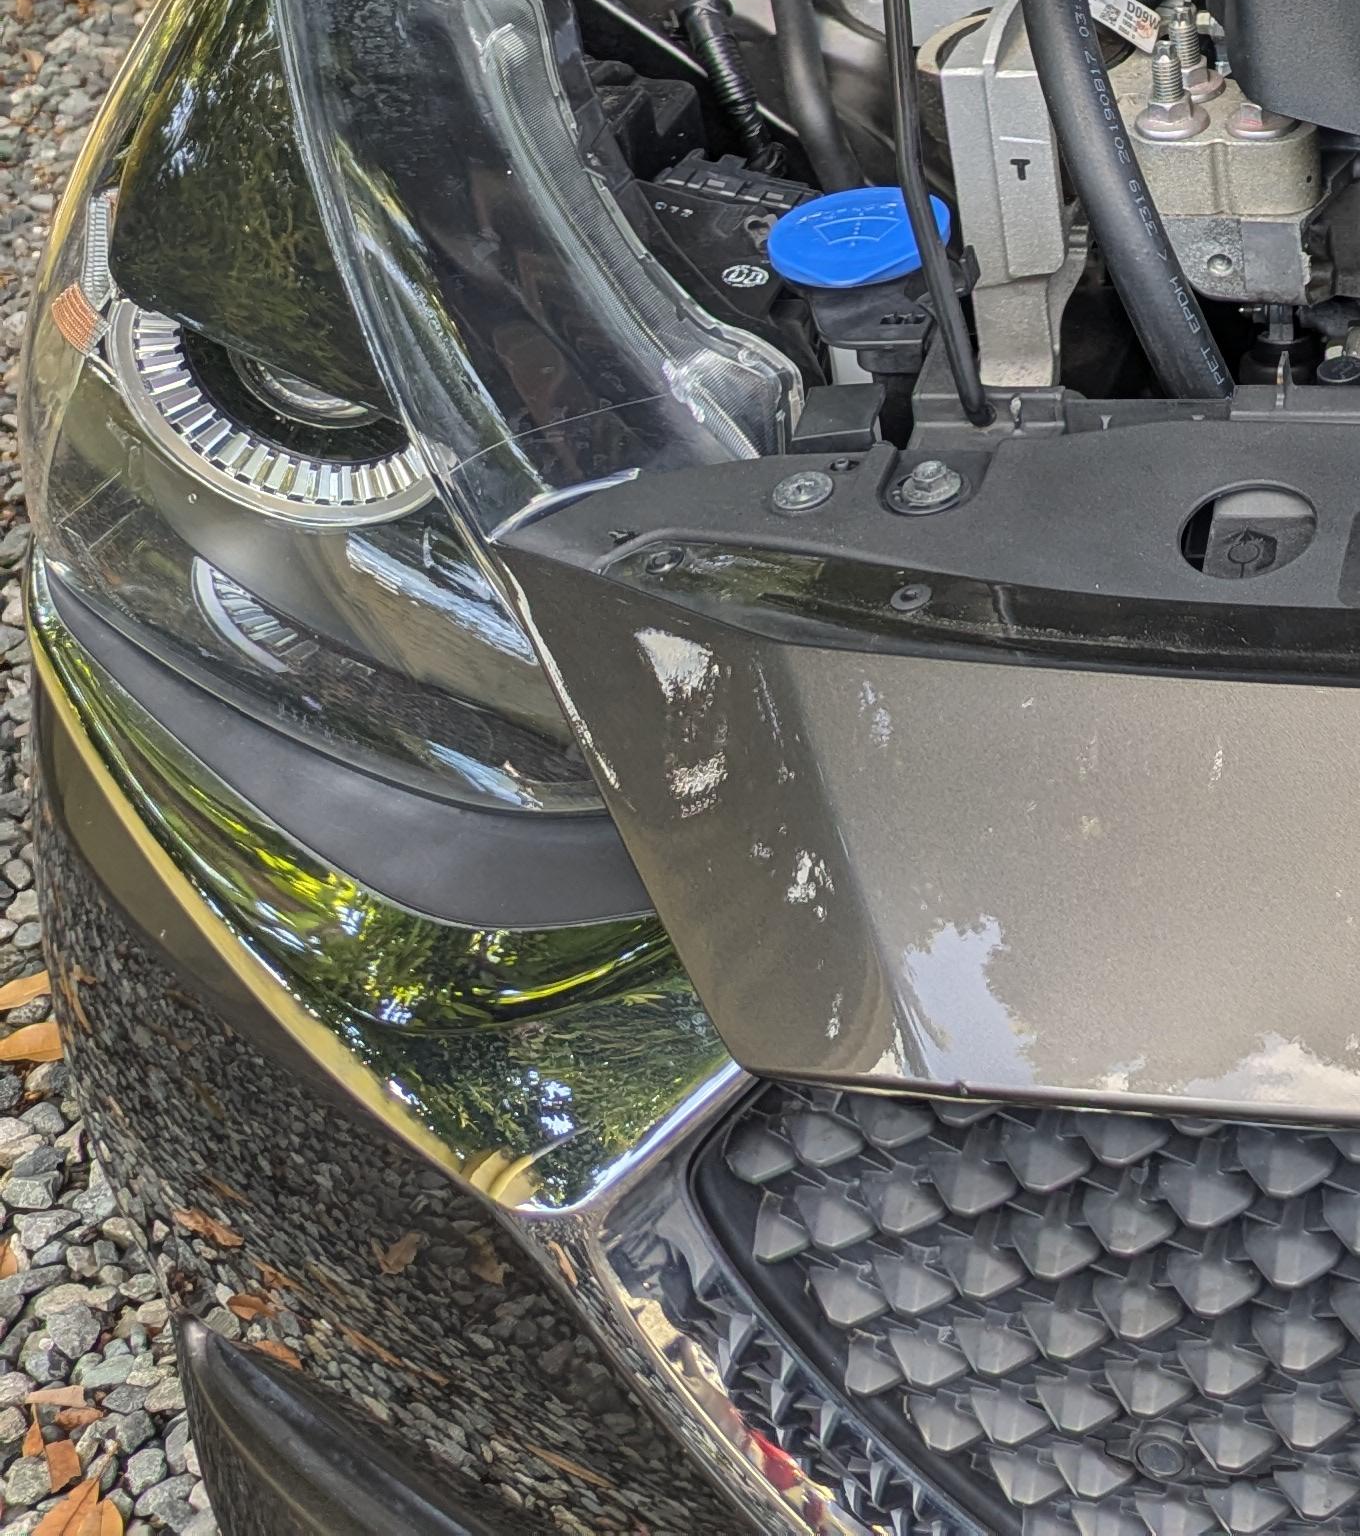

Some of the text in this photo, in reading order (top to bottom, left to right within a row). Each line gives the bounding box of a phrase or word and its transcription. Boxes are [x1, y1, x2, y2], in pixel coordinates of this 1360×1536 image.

[1083, 50, 1131, 165] 20190817
[1009, 158, 1034, 183] T
[1128, 179, 1159, 237] 3319
[1169, 276, 1201, 334] EPDM
[1201, 346, 1225, 386] PET
